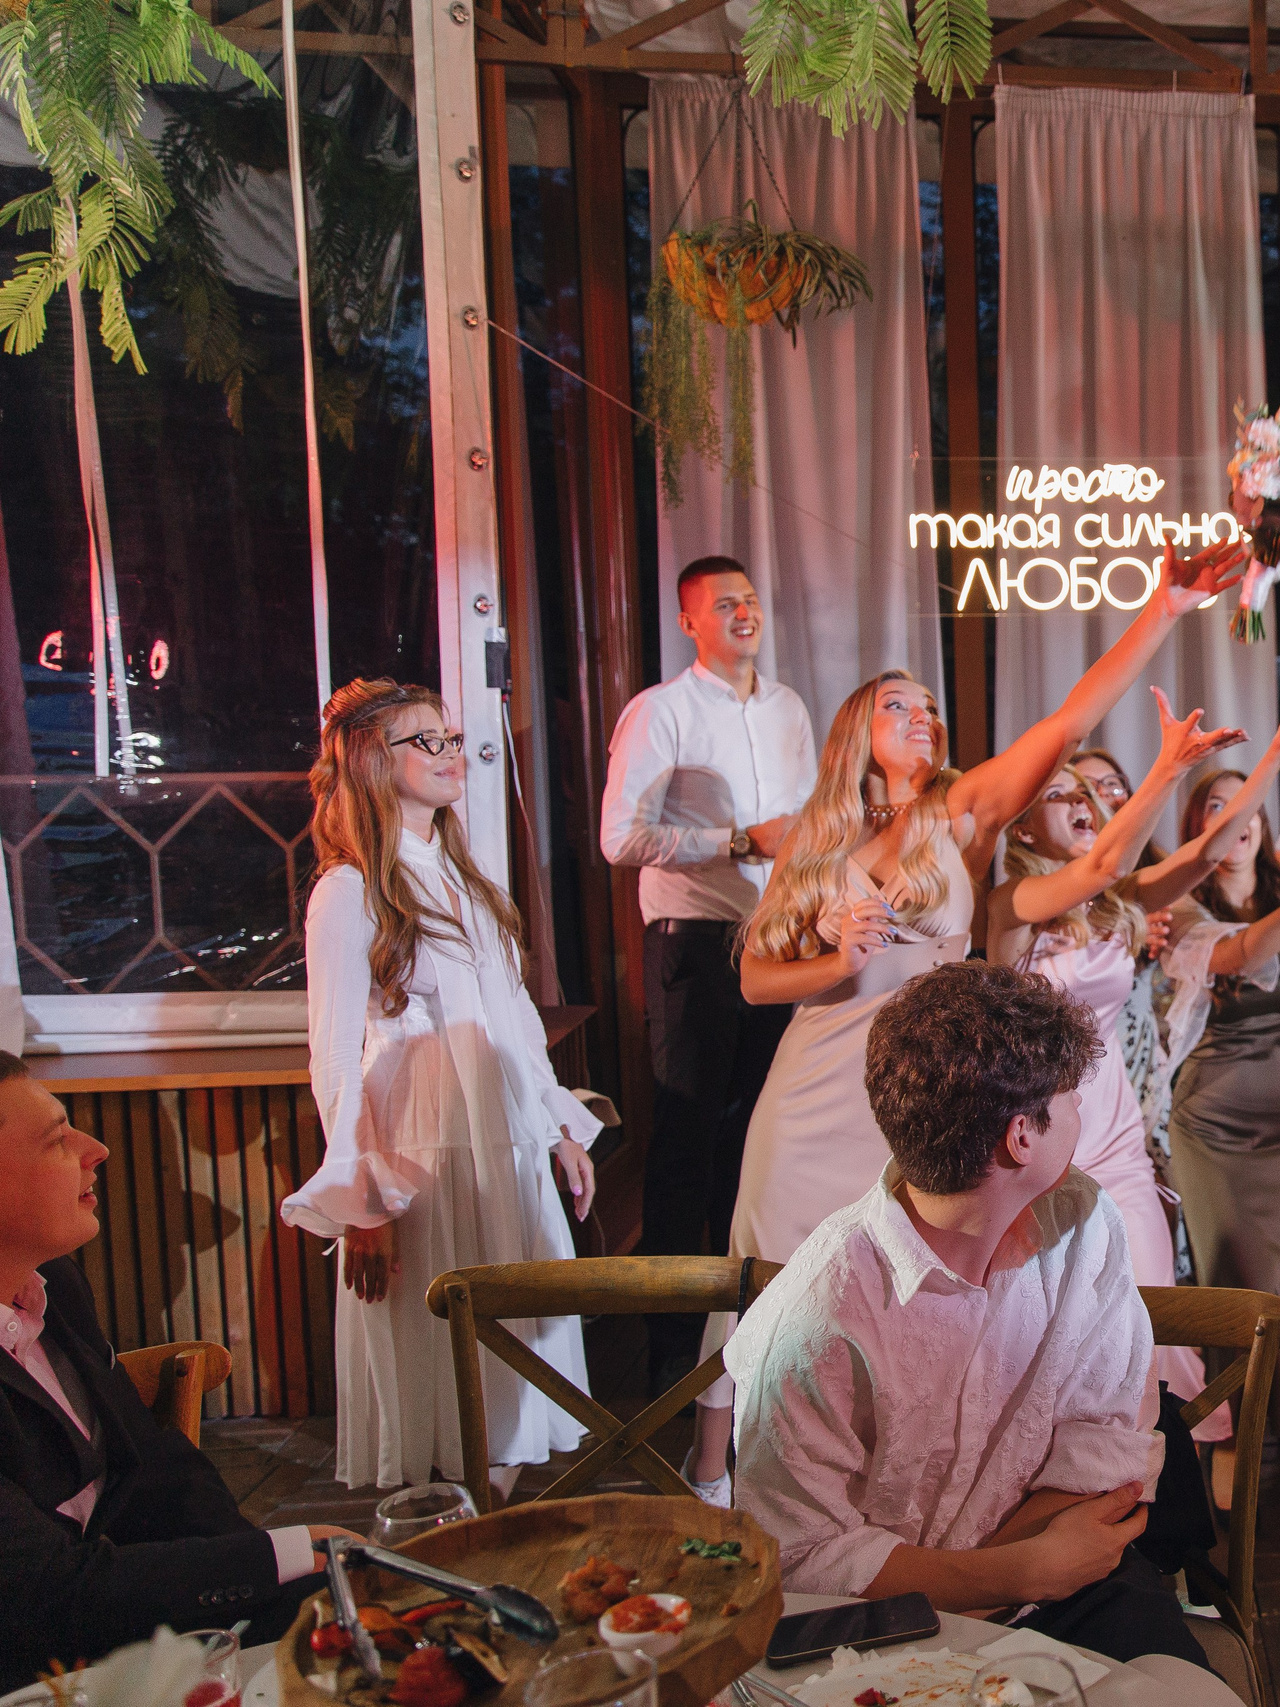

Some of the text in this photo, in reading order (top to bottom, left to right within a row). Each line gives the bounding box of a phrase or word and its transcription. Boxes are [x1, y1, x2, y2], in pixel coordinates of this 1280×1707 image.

[1005, 463, 1165, 514] просто
[909, 511, 1253, 549] такая сильна
[957, 555, 1219, 611] ЛЮБО
